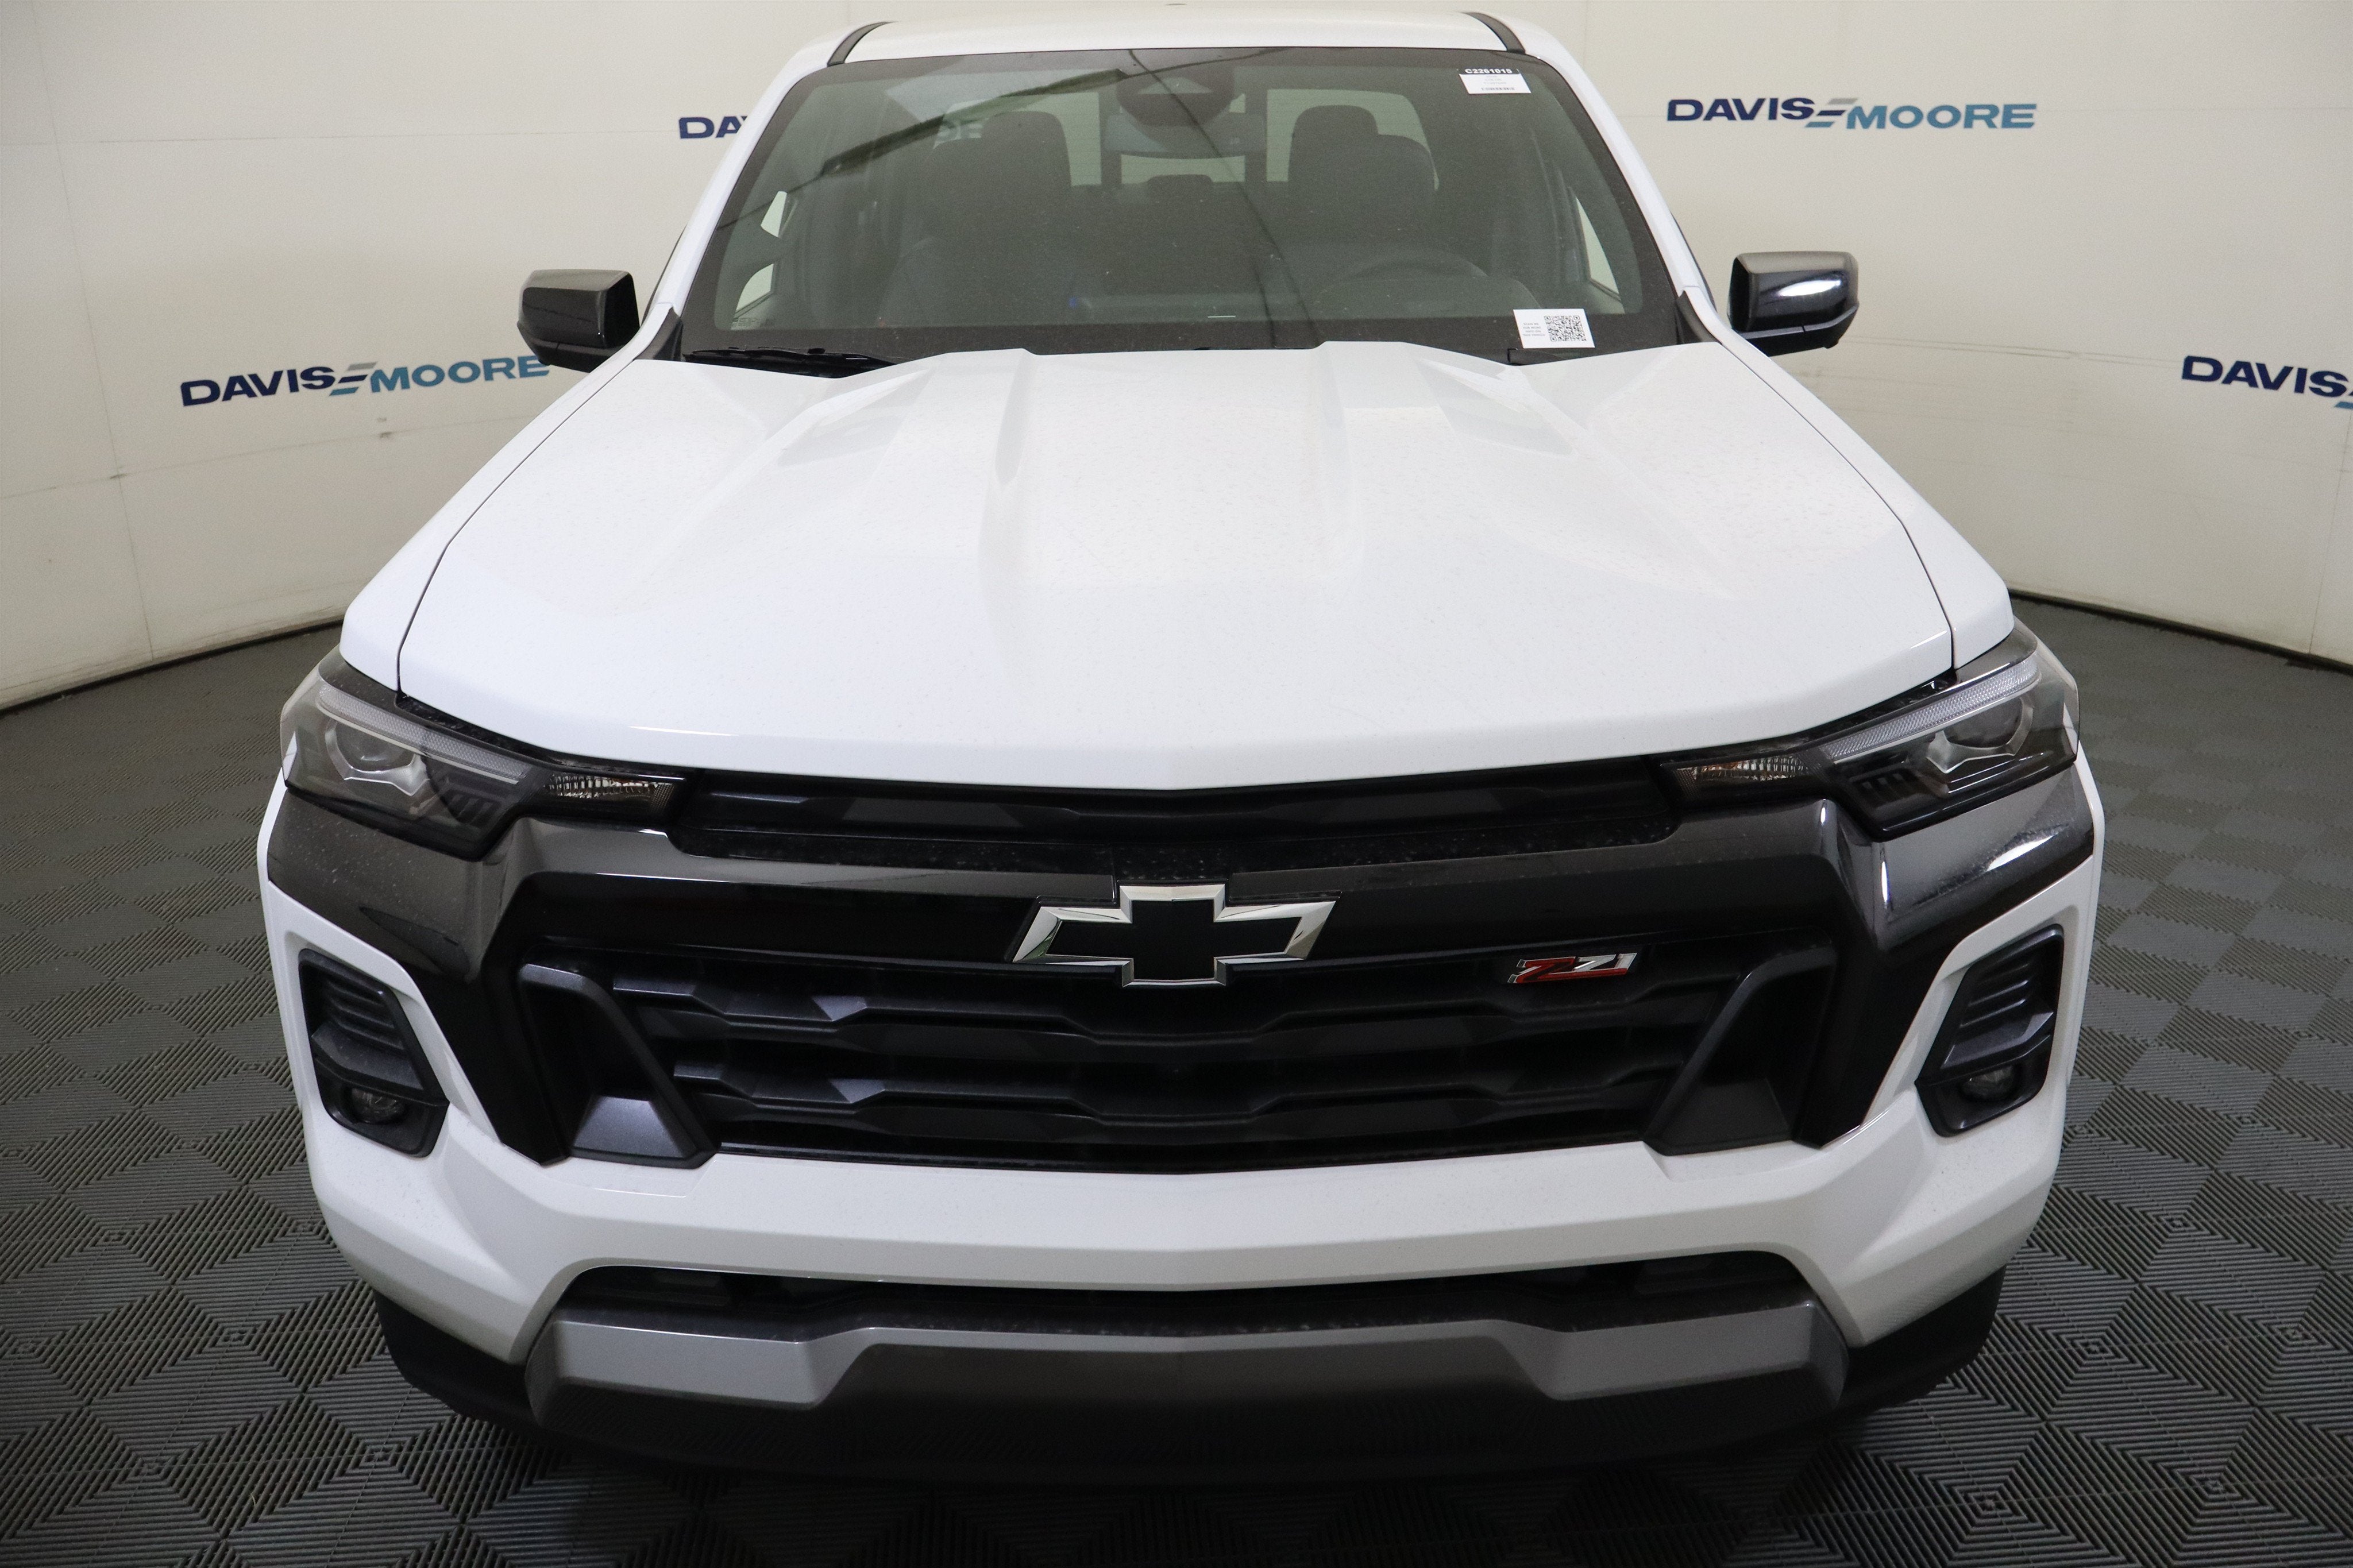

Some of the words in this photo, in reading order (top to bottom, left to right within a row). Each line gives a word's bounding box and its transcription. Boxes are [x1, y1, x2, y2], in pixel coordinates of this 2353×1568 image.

[678, 115, 748, 139] DA
[1666, 97, 1815, 121] DAVIS
[1846, 103, 2037, 129] MOORE
[180, 366, 335, 406] DAVIS
[370, 354, 550, 393] MOORE
[2181, 356, 2349, 397] DAVIS
[1507, 952, 1638, 984] Z71
